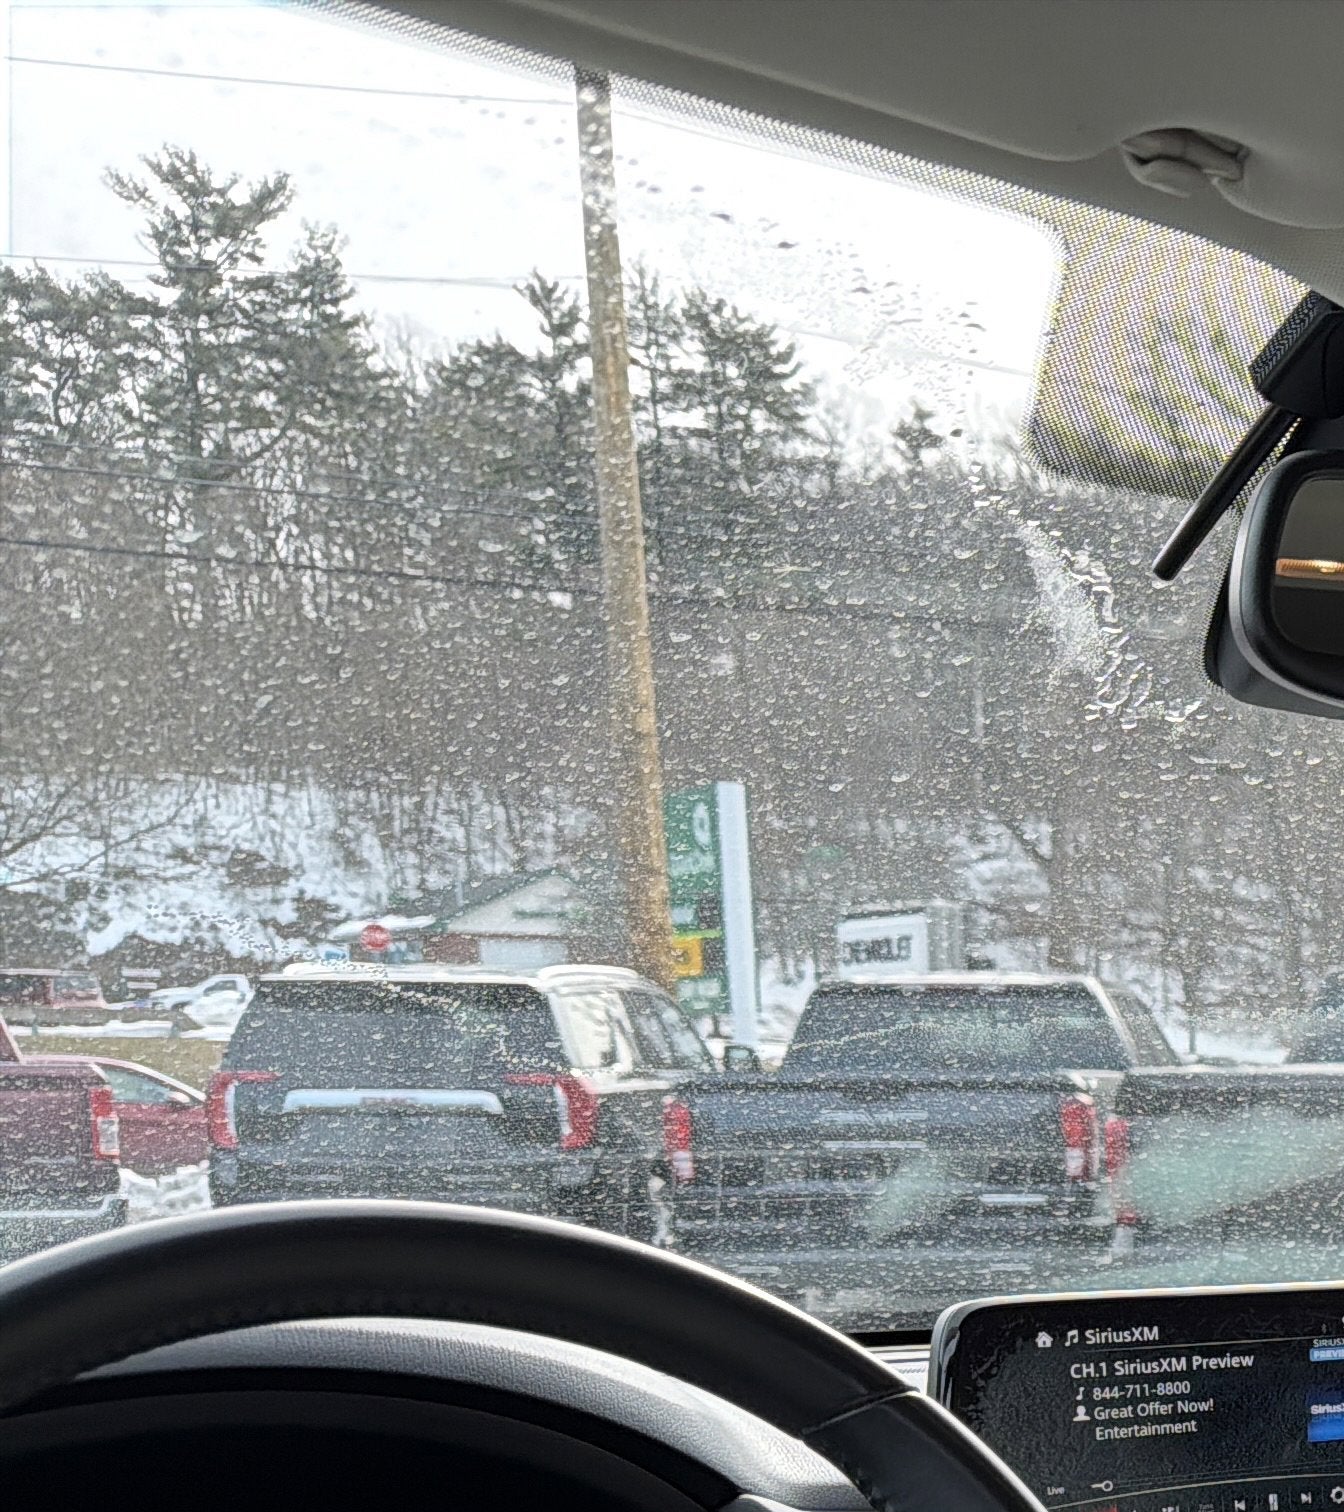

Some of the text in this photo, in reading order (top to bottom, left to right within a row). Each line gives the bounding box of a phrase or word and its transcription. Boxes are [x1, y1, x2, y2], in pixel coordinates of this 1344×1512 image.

[1085, 1326, 1160, 1345] SiriusXM
[1070, 1352, 1255, 1379] CH.1 SiriusXM Preview
[1092, 1380, 1192, 1401] 844-711-8800
[1094, 1398, 1215, 1420] Great Offer Now!
[1095, 1420, 1199, 1440] Entertainment
